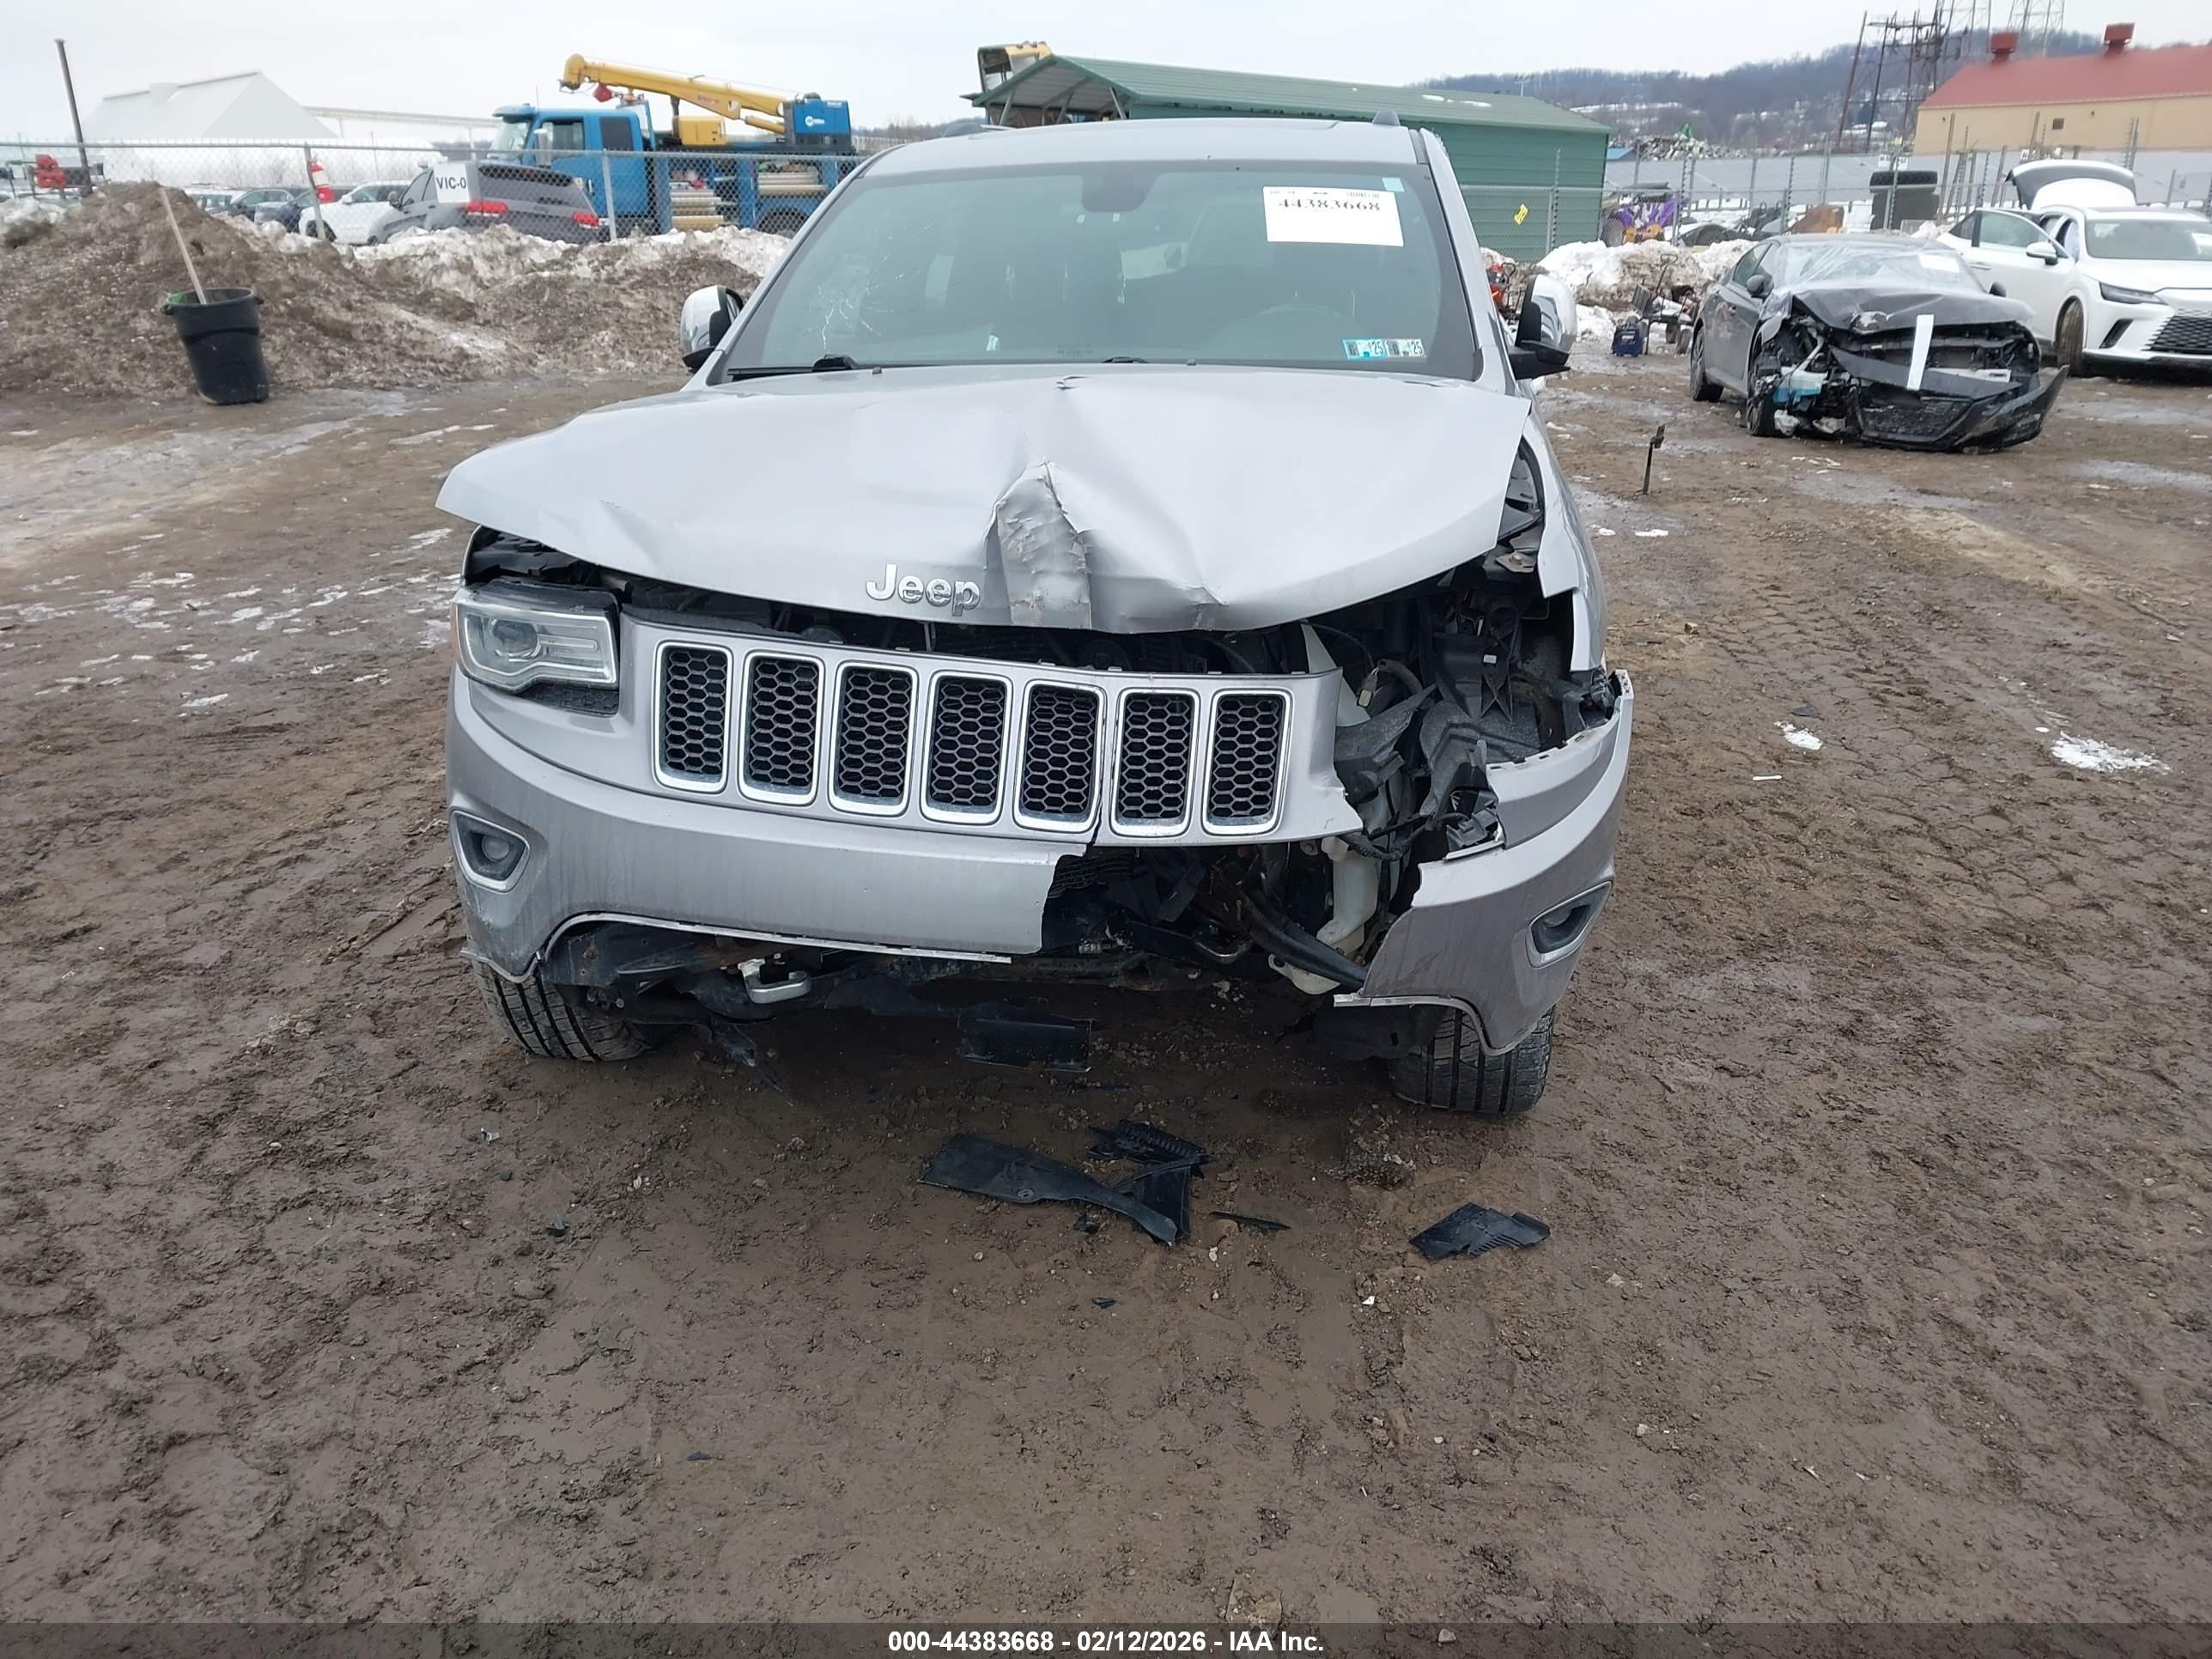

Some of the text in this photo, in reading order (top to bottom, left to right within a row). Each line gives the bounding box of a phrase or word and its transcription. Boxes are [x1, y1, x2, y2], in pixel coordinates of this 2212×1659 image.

[436, 177, 466, 189] VIC-0
[1279, 198, 1380, 211] 44383668
[866, 563, 981, 617] Jeep
